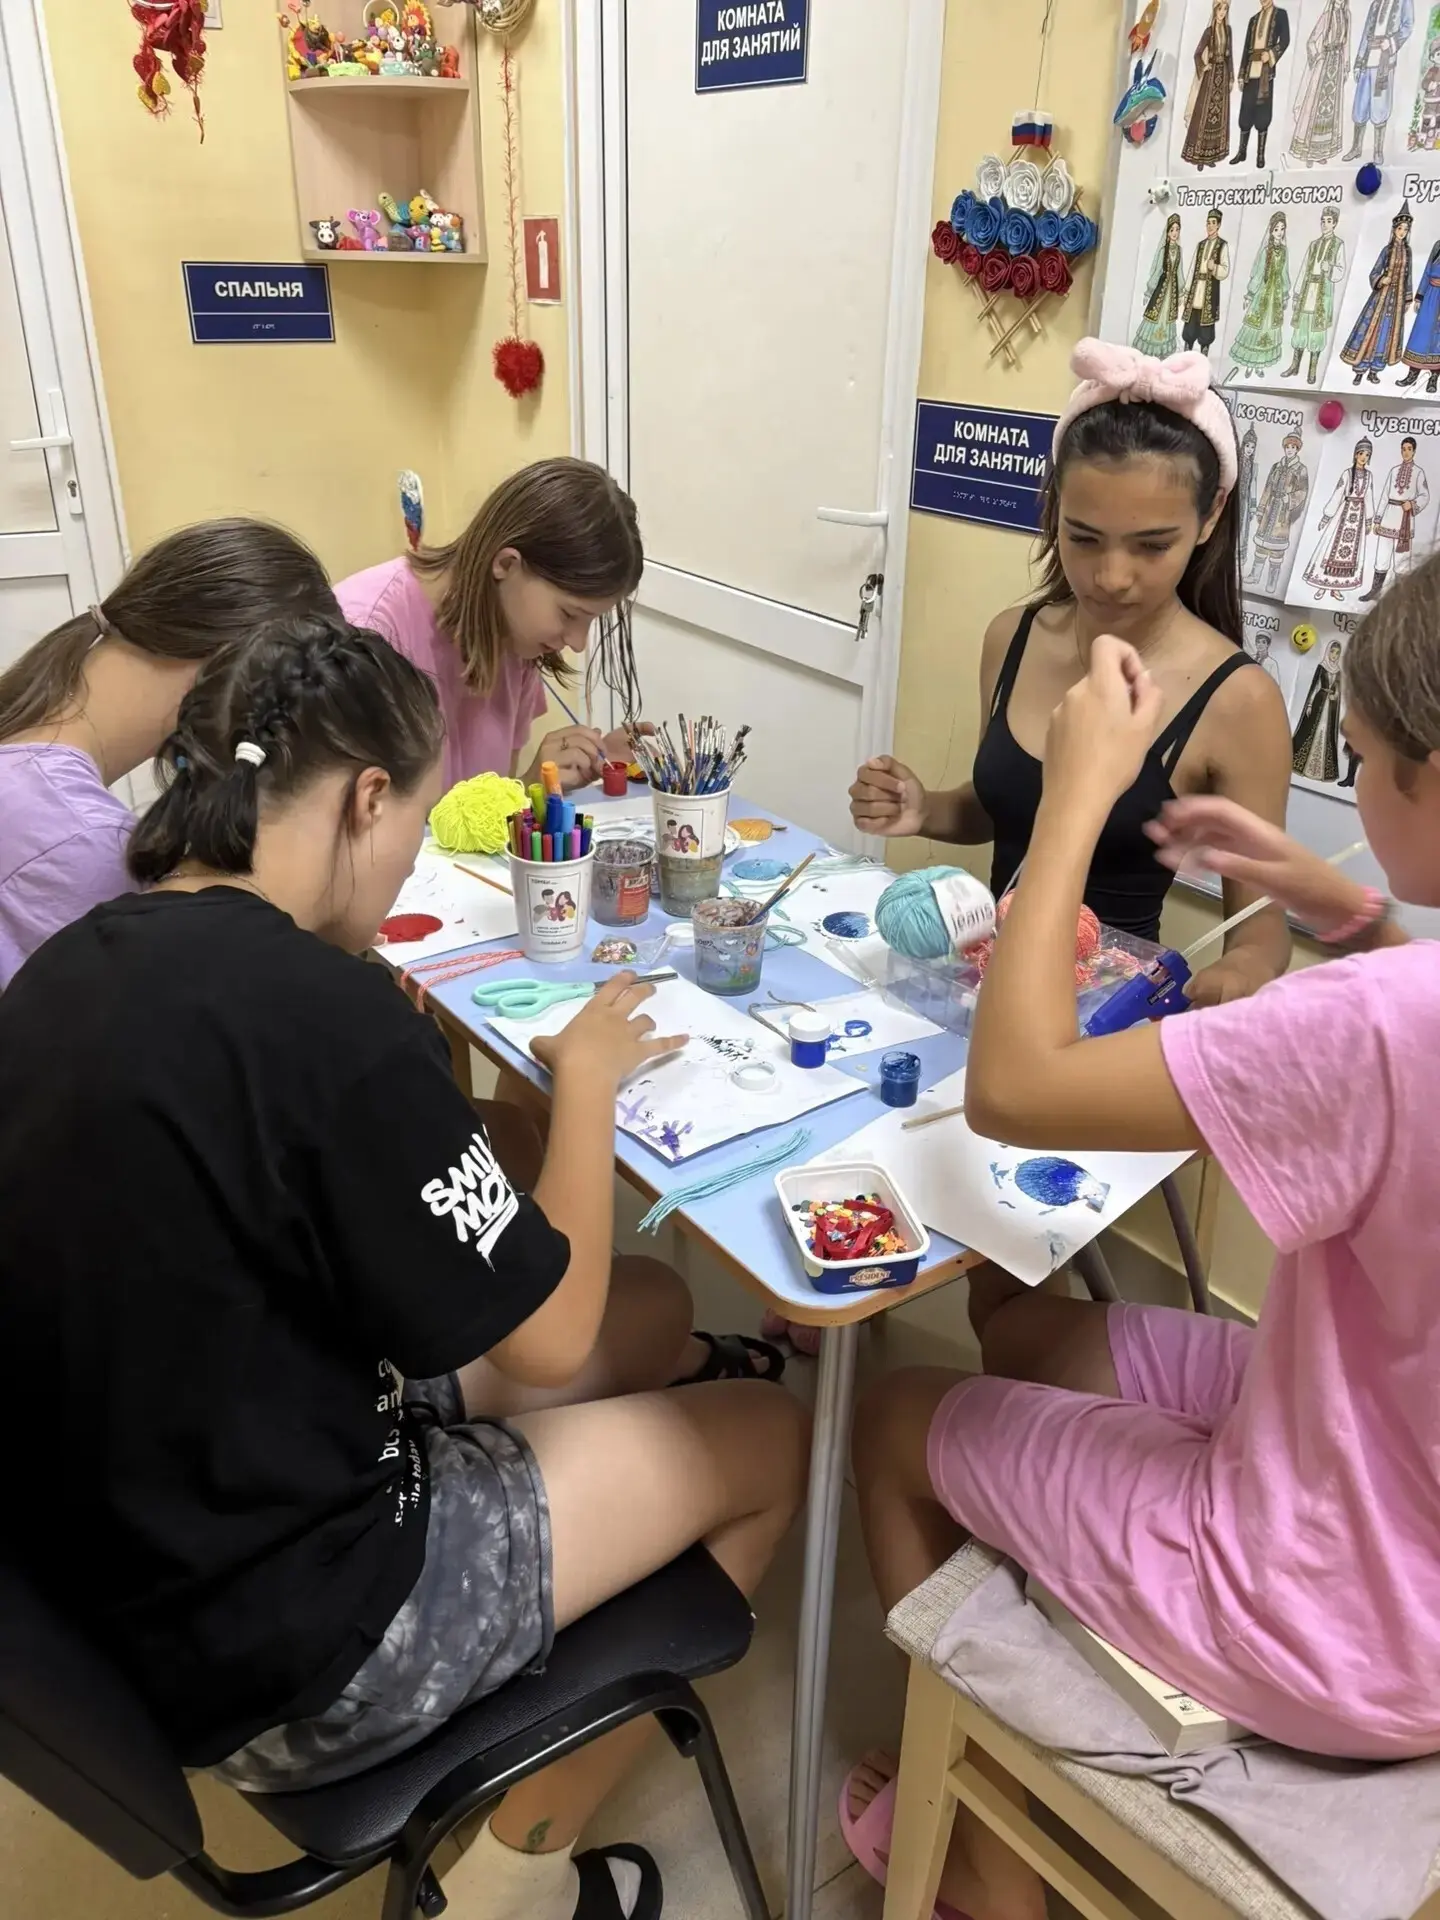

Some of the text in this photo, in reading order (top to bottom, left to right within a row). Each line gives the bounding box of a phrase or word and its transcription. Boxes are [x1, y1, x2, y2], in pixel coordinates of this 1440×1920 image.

[717, 0, 785, 32] КОМНАТА
[701, 22, 801, 66] ДЛЯ ЗАНЯТИЙ
[1177, 185, 1344, 208] Татарский костюм
[214, 281, 304, 298] СПАЛЬНЯ
[1236, 403, 1304, 427] костюм
[953, 420, 1030, 449] КОМНАТА
[933, 443, 1048, 478] ДЛЯ ЗАНЯТИЙ
